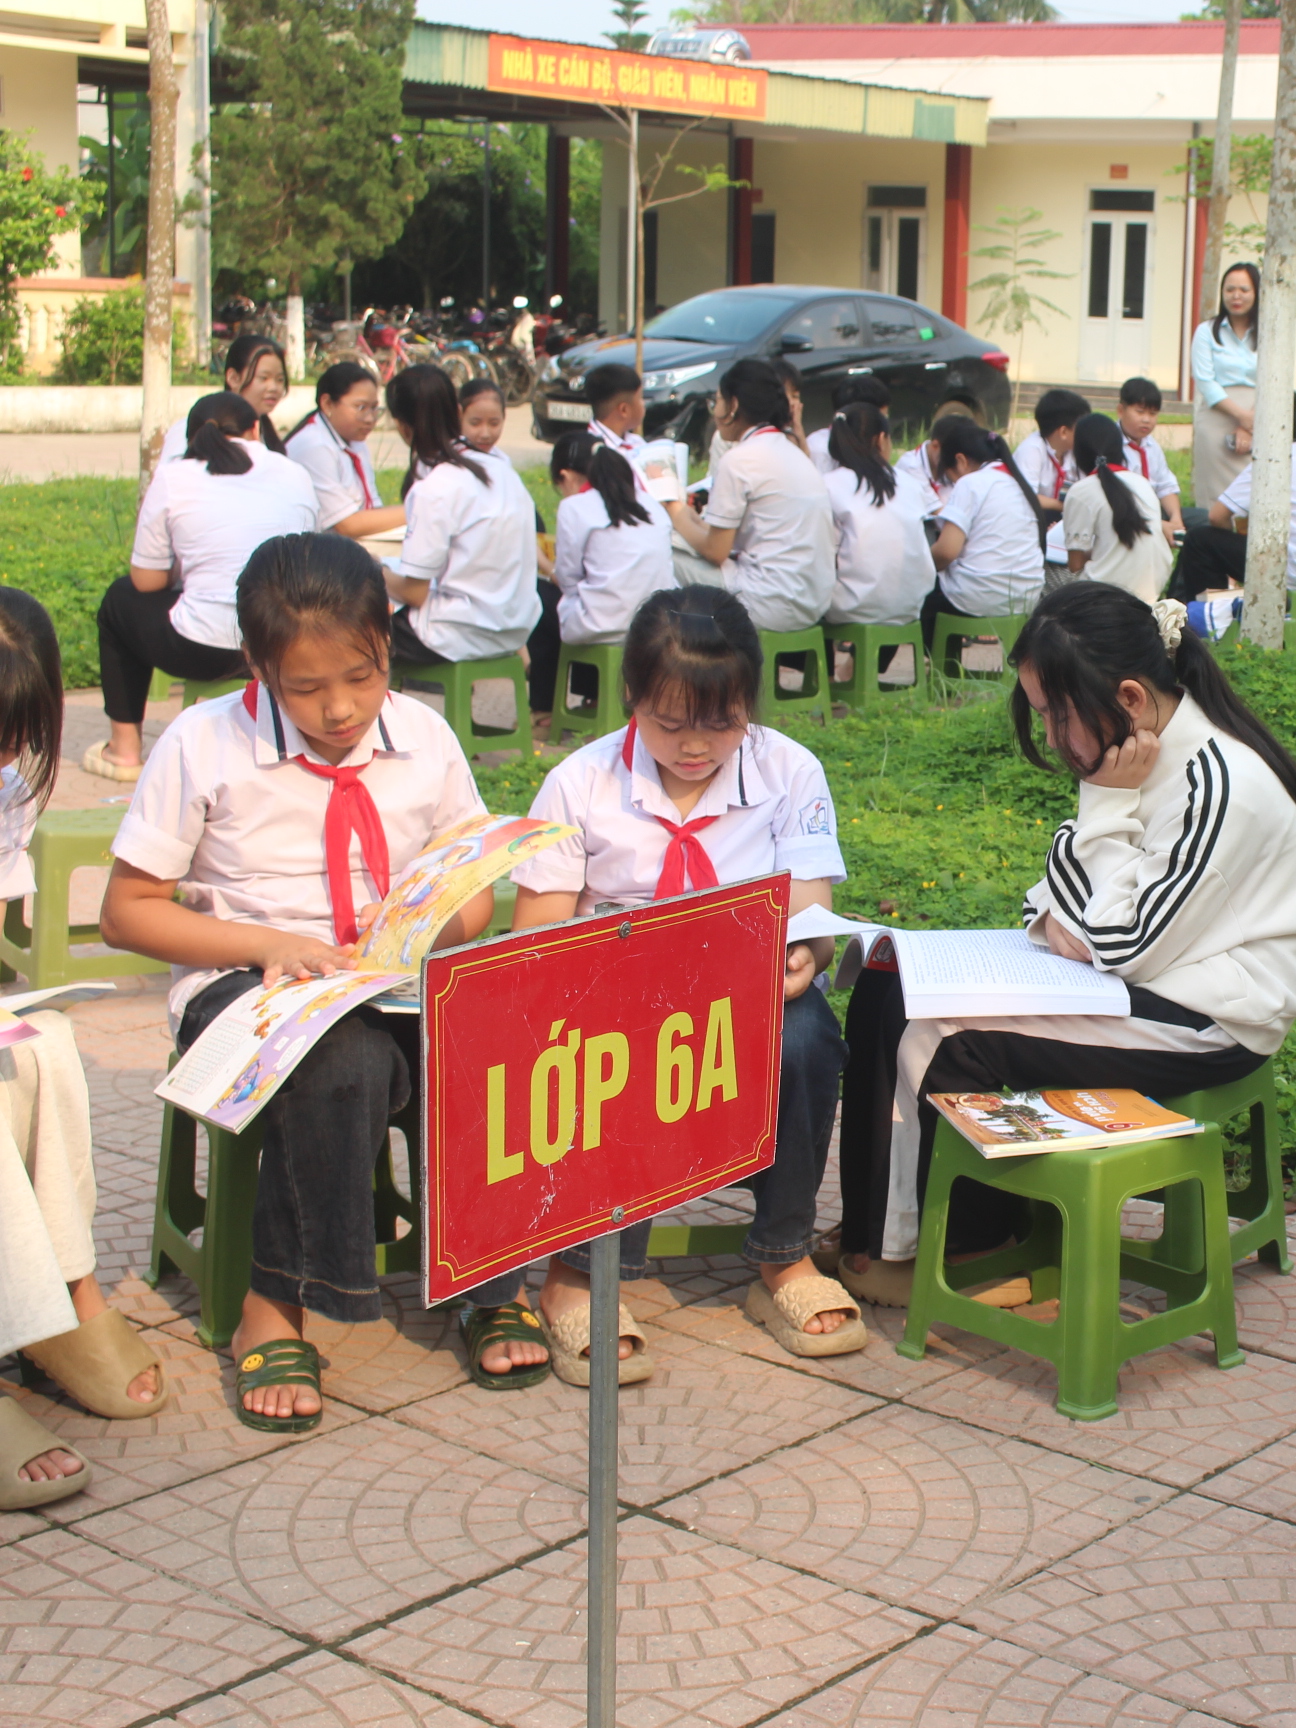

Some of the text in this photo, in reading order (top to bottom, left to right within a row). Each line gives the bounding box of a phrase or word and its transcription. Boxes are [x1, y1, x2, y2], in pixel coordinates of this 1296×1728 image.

[502, 46, 534, 82] NHÀ
[536, 54, 557, 85] XE
[559, 52, 590, 89] CÁN
[618, 61, 651, 96] GIÁO
[689, 71, 727, 105] NHÂN
[728, 75, 757, 109] VIÊN
[487, 996, 739, 1186] LỚP 6A
[1104, 1122, 1145, 1131] 6
